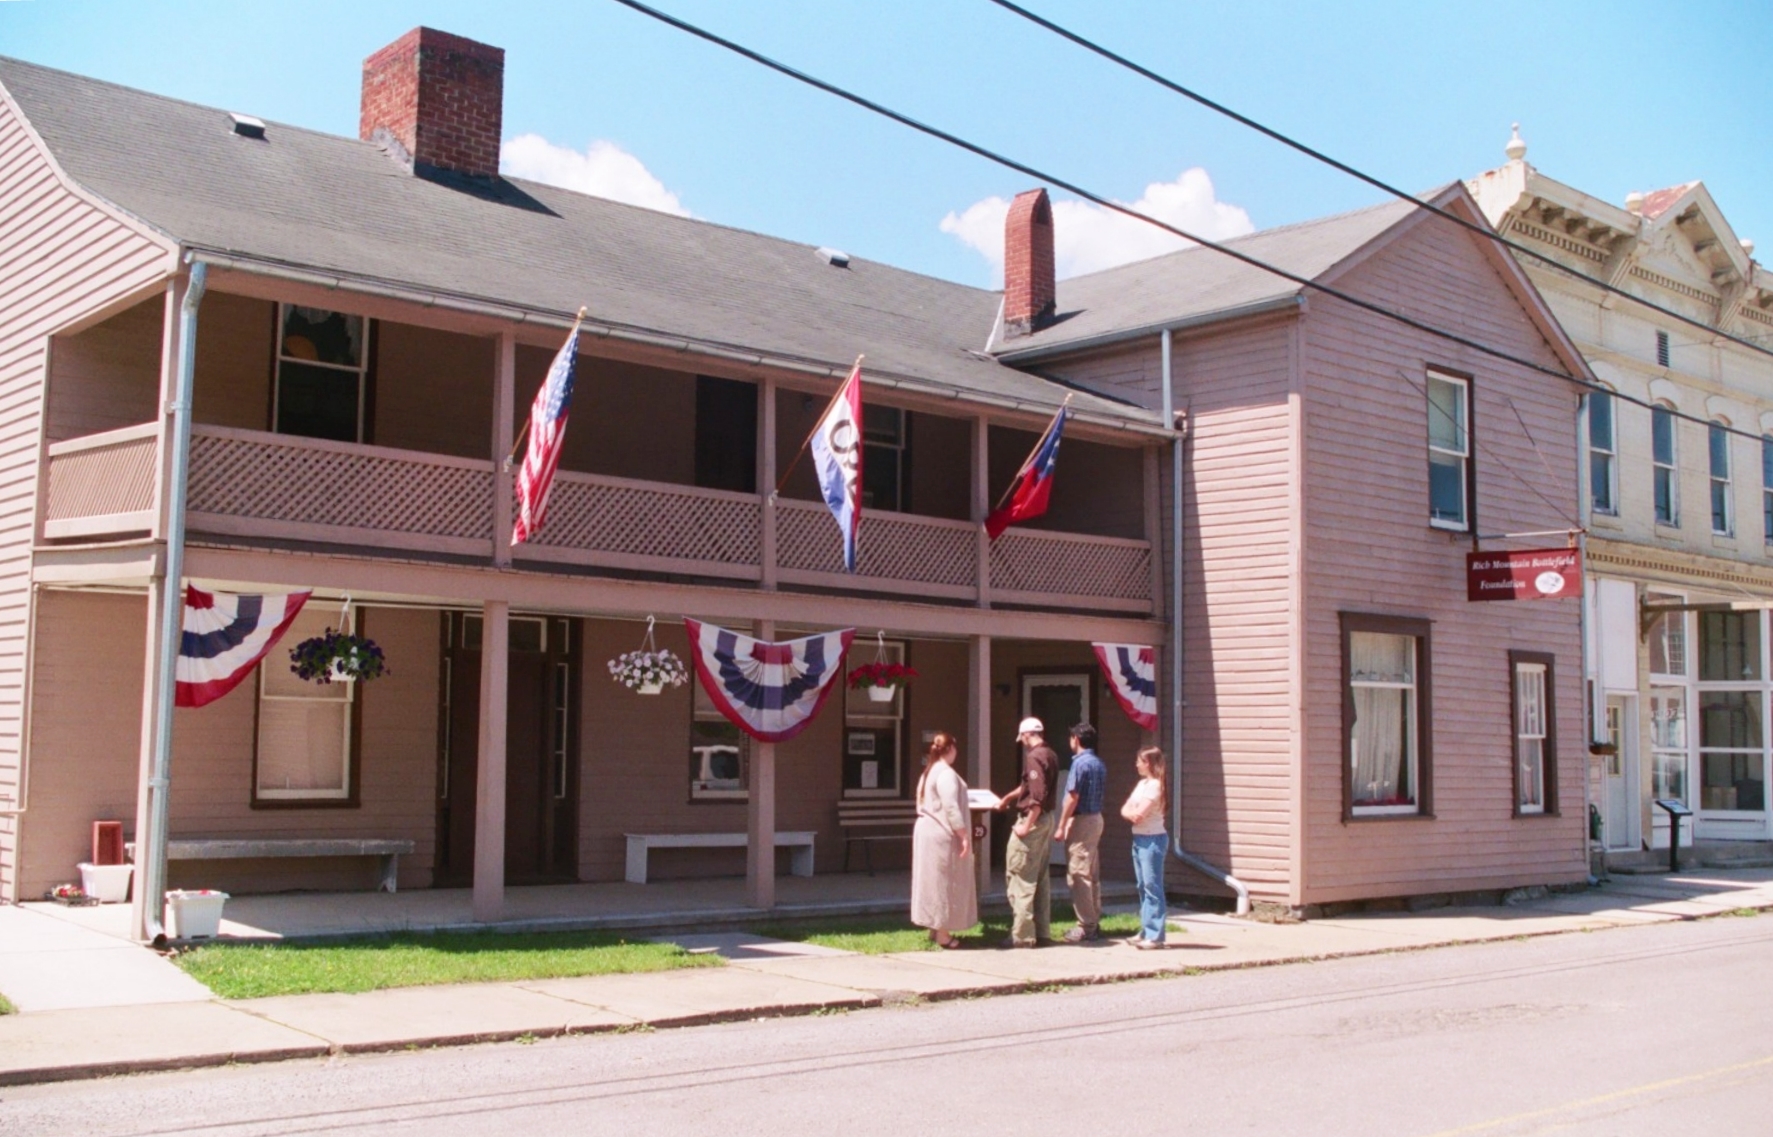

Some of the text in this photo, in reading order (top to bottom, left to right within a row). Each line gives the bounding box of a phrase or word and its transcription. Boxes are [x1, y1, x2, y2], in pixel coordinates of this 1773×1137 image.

[1473, 556, 1574, 570] Rich Mountain Battlefield
[1480, 579, 1526, 589] Foundation
